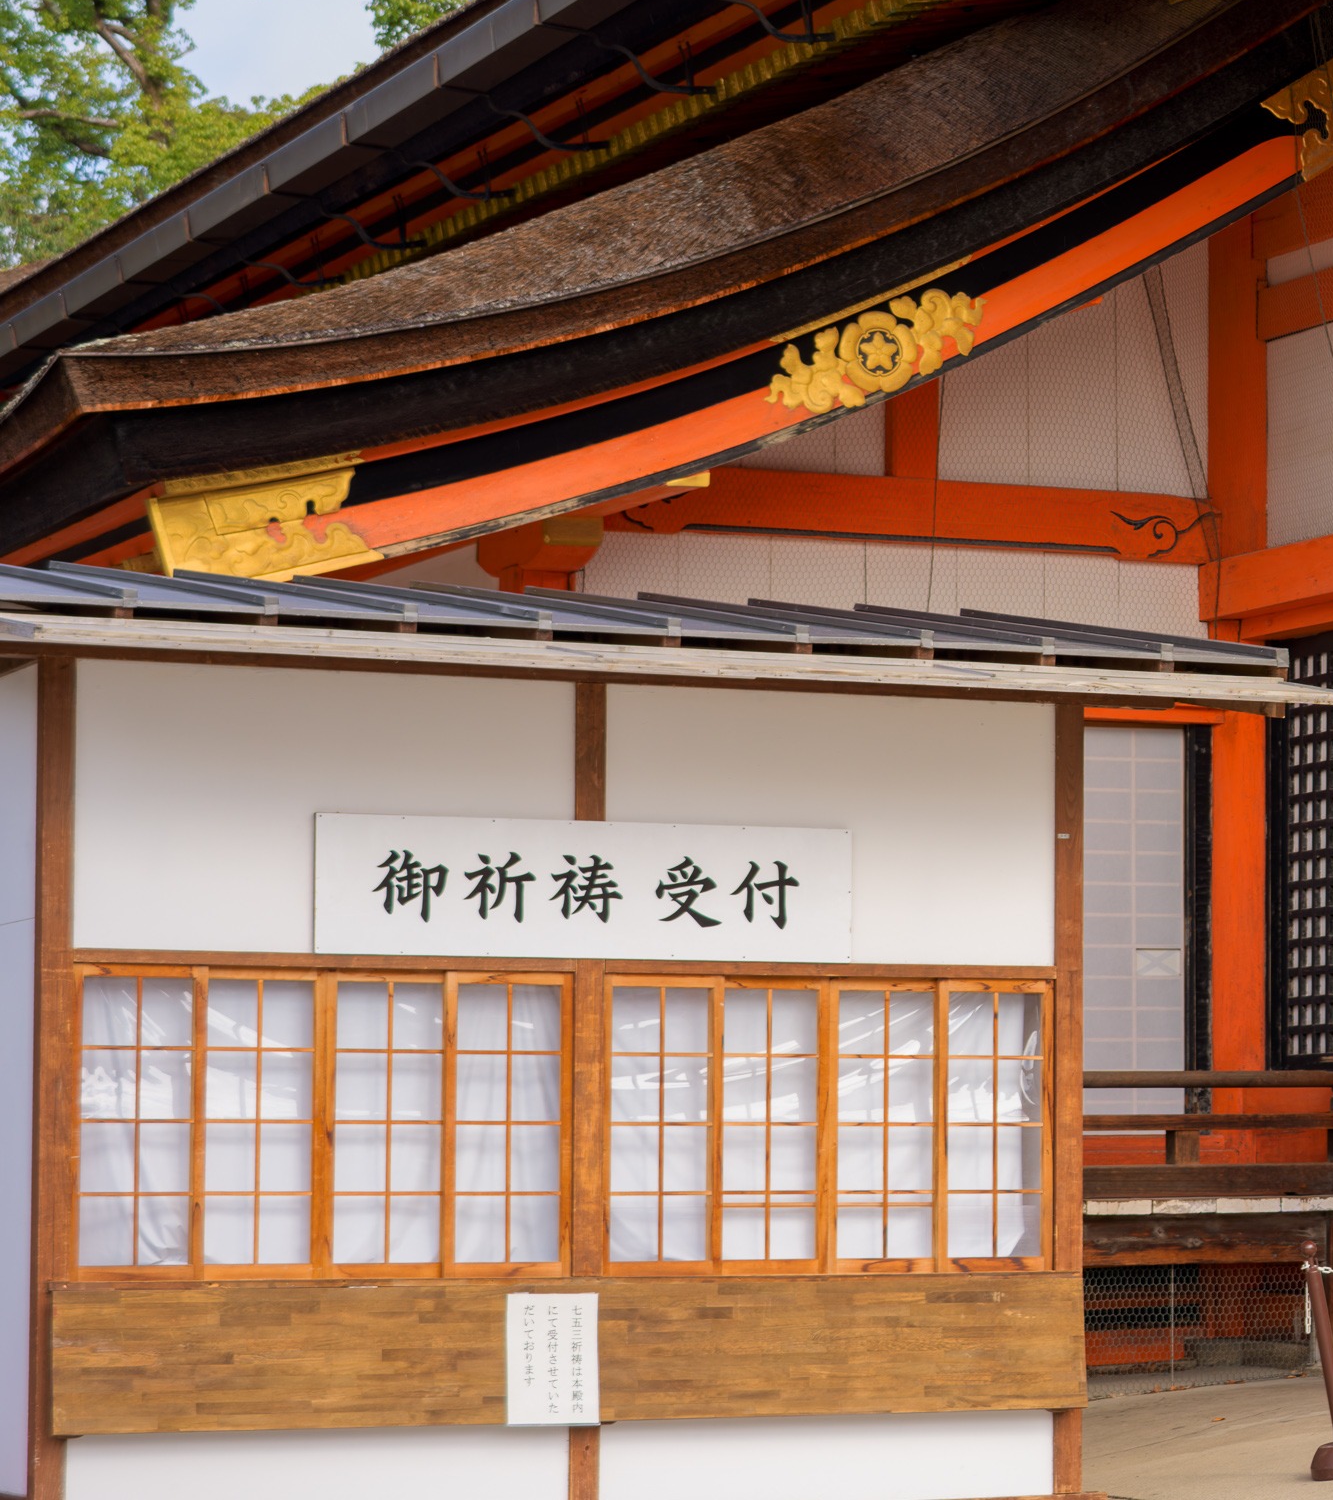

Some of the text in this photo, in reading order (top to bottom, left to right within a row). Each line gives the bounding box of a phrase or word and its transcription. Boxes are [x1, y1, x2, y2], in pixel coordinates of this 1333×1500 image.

[523, 1304, 536, 1387] だいております
[547, 1305, 560, 1414] にて受付させていた
[571, 1305, 584, 1414] 七五三祈祷は本殿内
